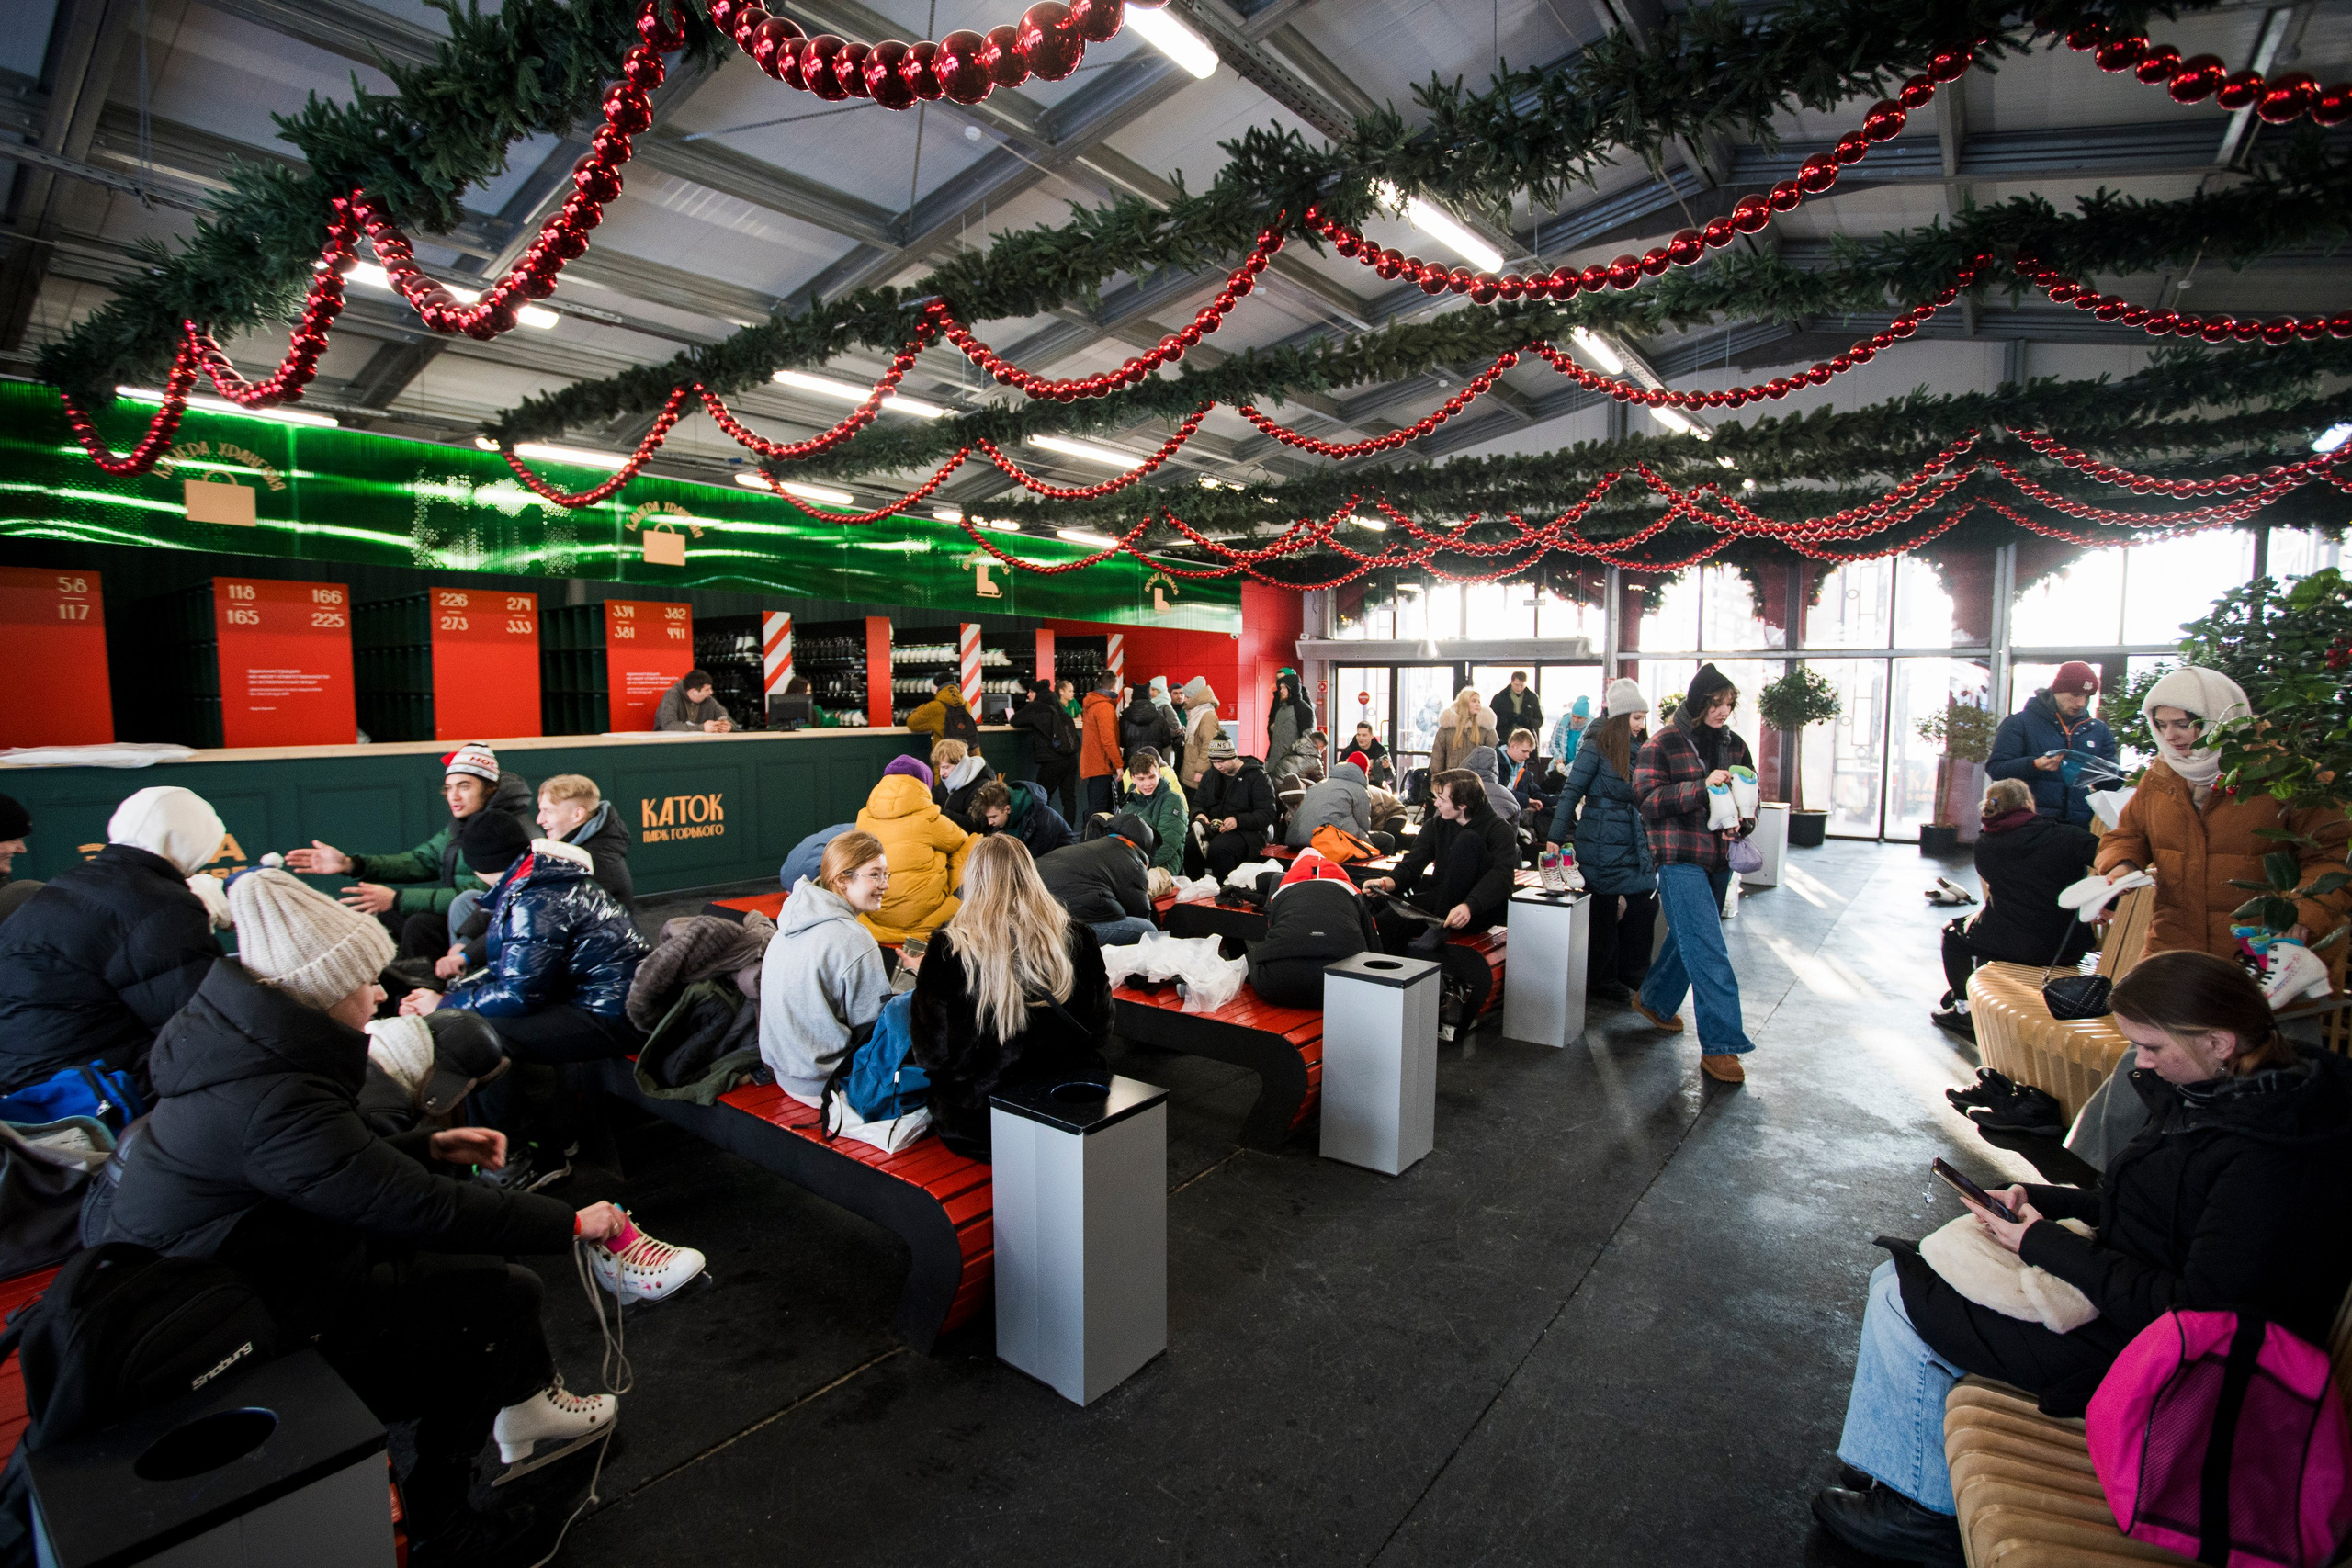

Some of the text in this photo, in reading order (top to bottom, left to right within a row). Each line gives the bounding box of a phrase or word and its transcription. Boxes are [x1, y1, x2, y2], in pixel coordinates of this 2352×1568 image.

[57, 576, 88, 593] 58
[228, 584, 255, 600] 118
[312, 589, 343, 604] 166
[439, 592, 469, 607] 226
[59, 604, 90, 620] 117
[506, 597, 532, 612] 274
[613, 604, 635, 618] 334
[227, 609, 260, 625] 165
[311, 612, 345, 627] 225
[664, 607, 686, 620] 382
[441, 616, 469, 631] 273
[506, 620, 533, 634] 333
[615, 626, 635, 639] 381
[667, 627, 686, 639] 441
[641, 793, 724, 829] КАТОК
[643, 823, 725, 843] ПАРК ГОРЬКОГО
[191, 1341, 253, 1390] Snoburg
